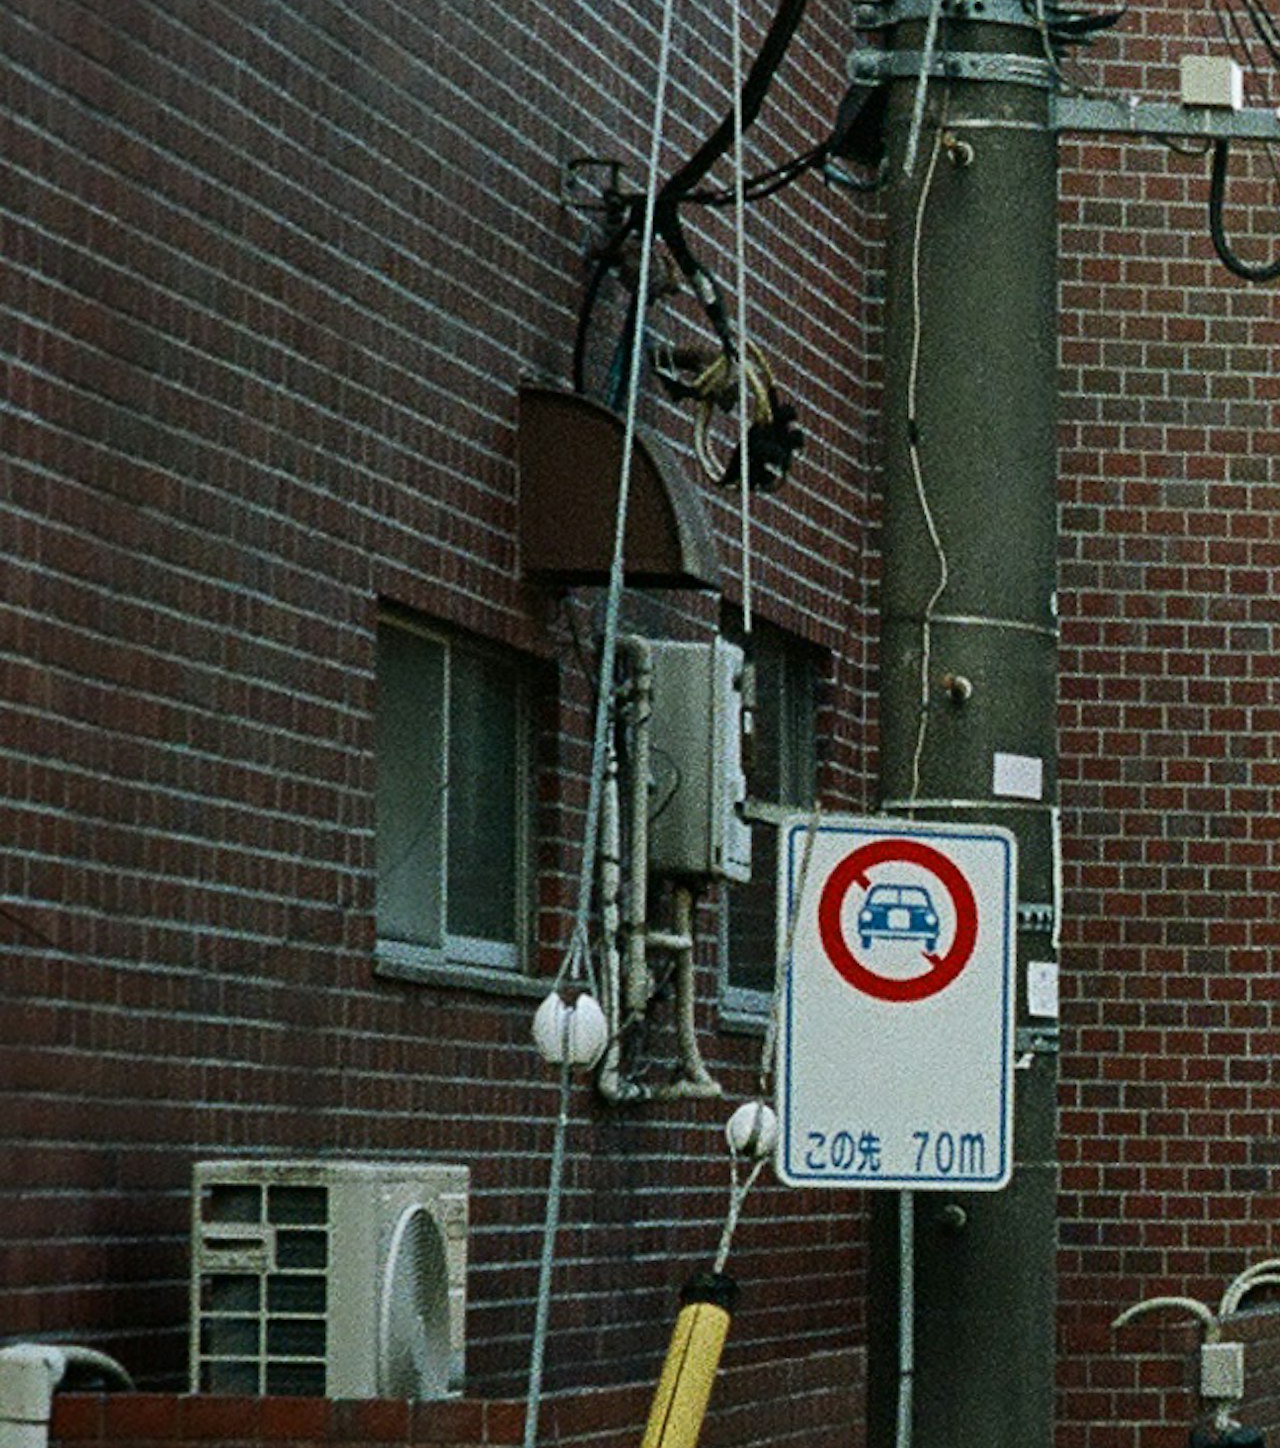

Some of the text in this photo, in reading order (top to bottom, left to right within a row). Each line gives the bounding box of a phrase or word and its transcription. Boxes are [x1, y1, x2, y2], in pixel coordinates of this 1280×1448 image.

[806, 1130, 986, 1174] この先 70m
